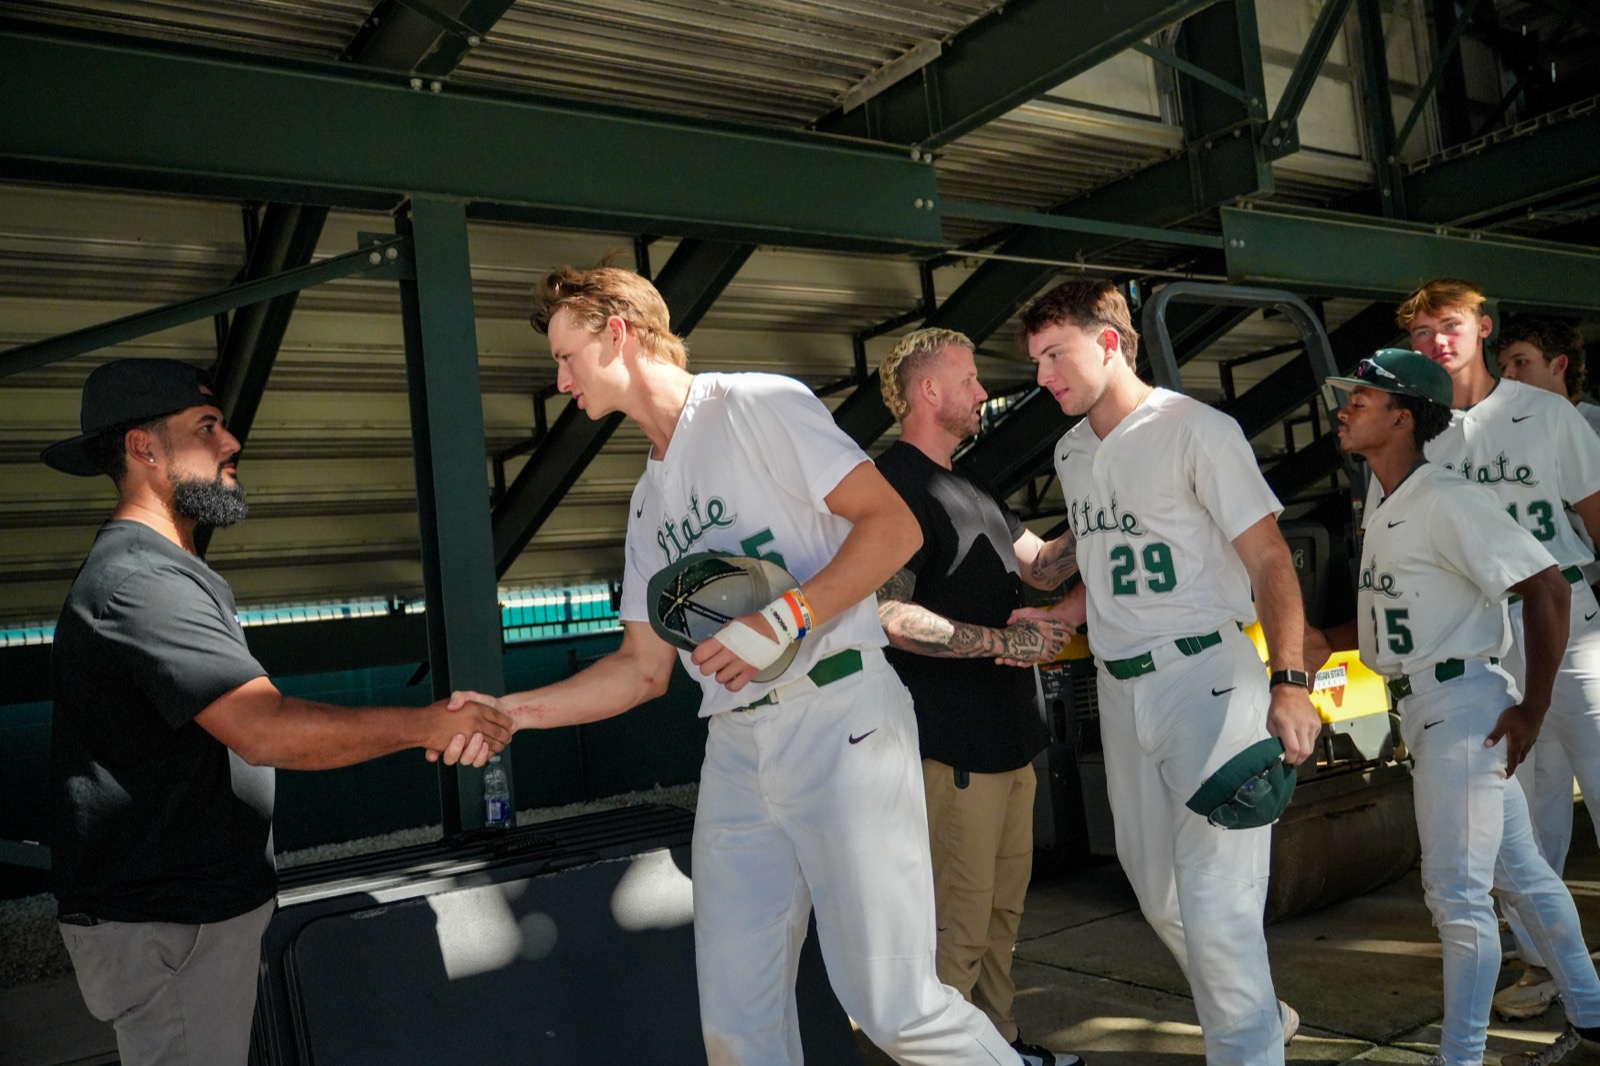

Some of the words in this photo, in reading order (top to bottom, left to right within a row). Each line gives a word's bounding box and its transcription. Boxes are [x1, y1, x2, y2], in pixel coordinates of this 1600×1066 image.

[1443, 451, 1539, 488] tate
[1070, 493, 1147, 539] State
[719, 526, 788, 572] 5
[1109, 542, 1177, 597] 29
[1358, 555, 1403, 599] ate
[1371, 605, 1415, 656] 5
[1330, 667, 1345, 679] STATE
